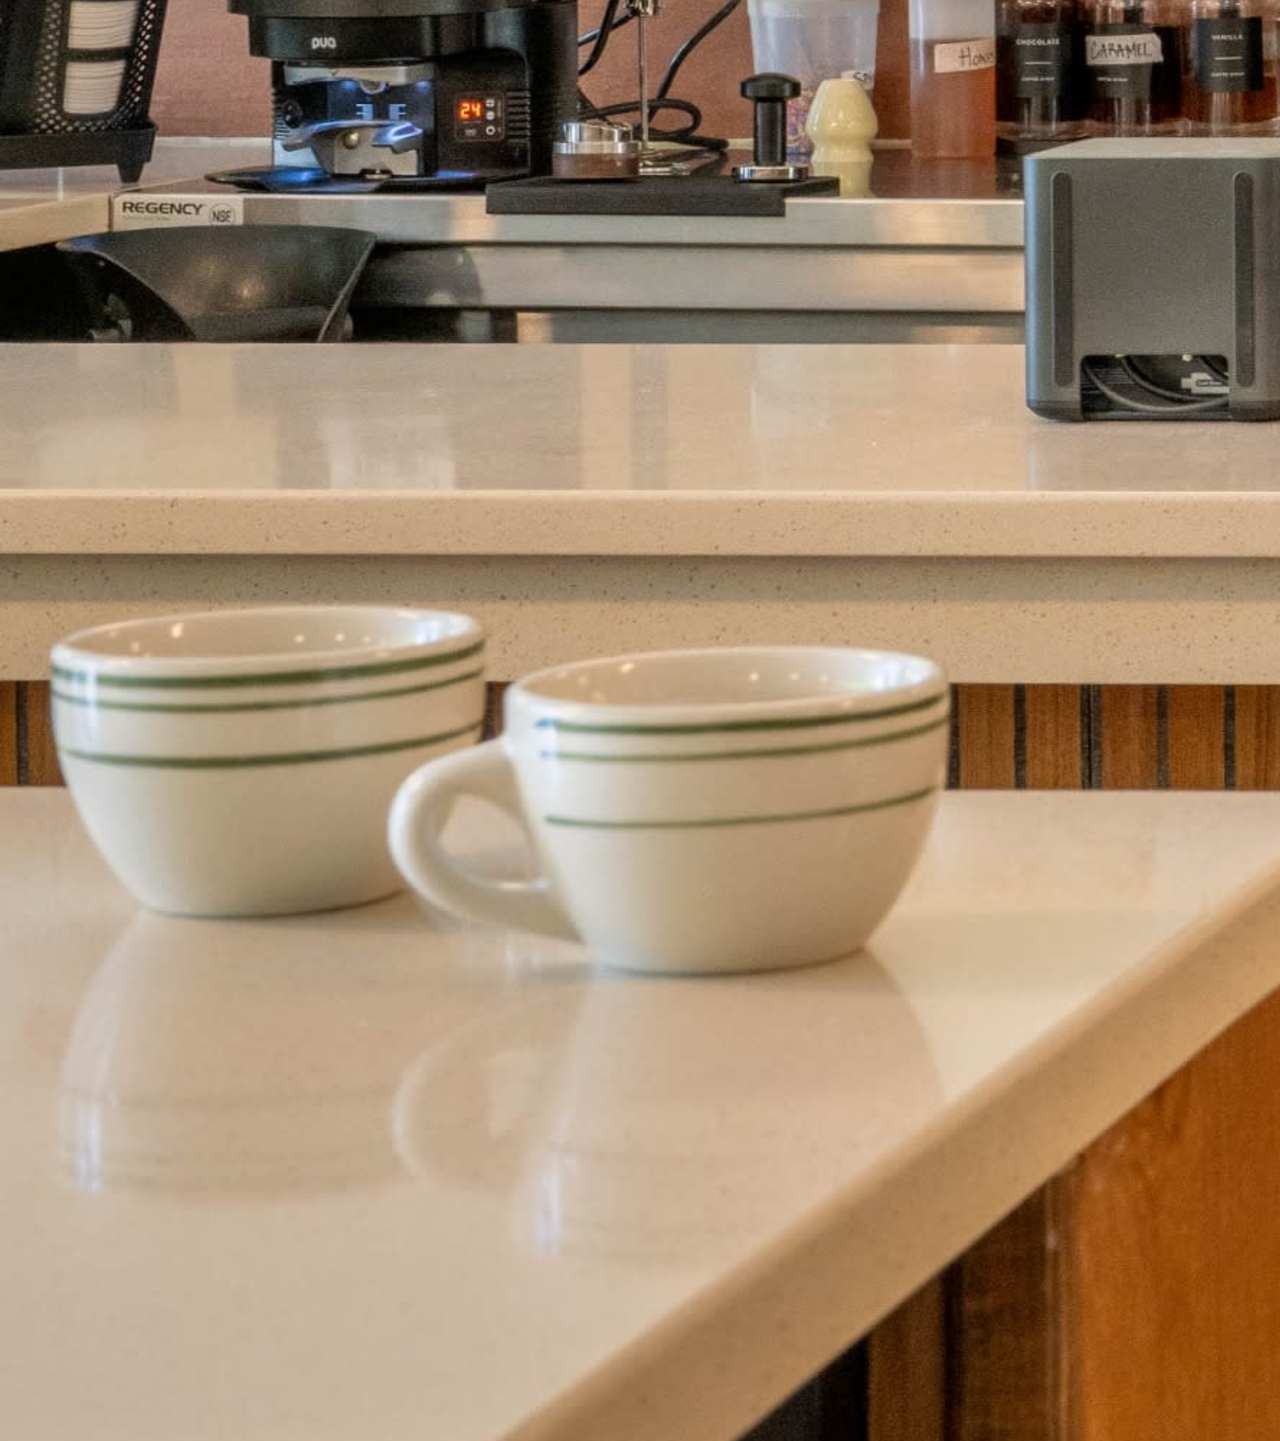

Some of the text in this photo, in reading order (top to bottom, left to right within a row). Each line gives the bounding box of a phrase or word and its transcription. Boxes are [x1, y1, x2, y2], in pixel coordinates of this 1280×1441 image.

[1016, 38, 1060, 46] CHOCOLATE
[1211, 33, 1243, 42] VANILLA
[1090, 41, 1152, 61] CARAMEL
[460, 101, 482, 119] 24
[122, 201, 202, 215] REGENCY
